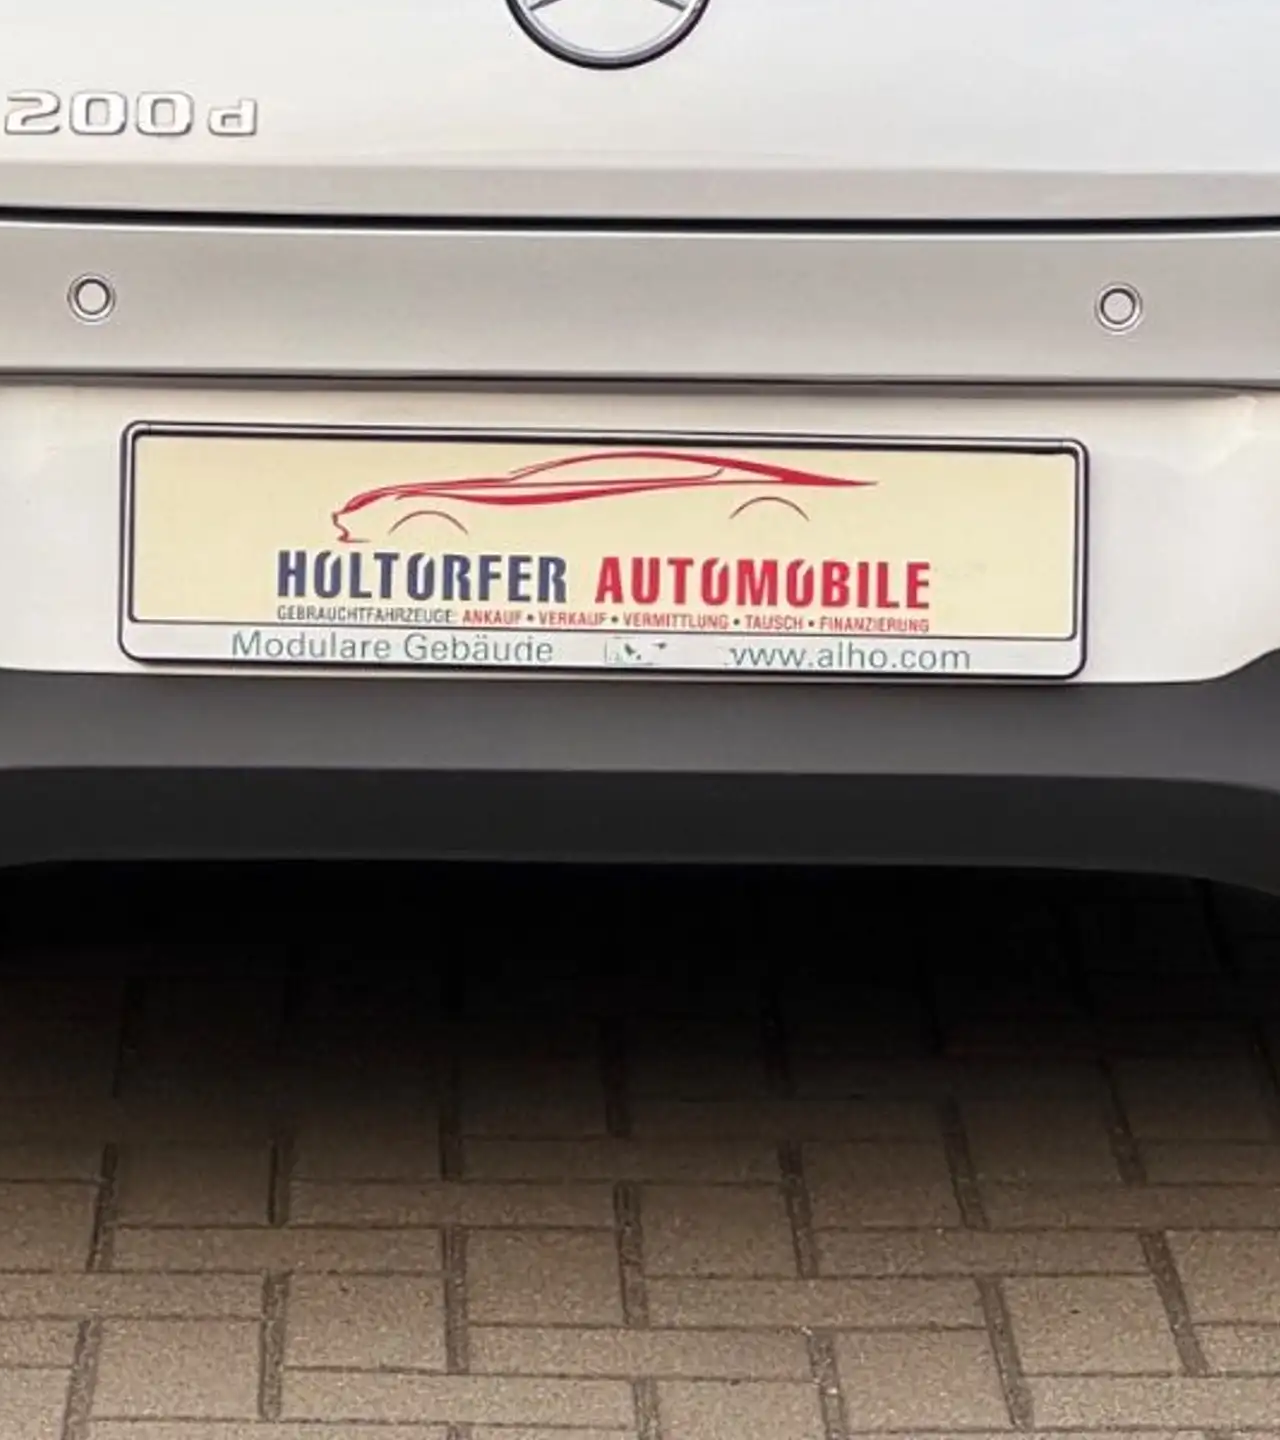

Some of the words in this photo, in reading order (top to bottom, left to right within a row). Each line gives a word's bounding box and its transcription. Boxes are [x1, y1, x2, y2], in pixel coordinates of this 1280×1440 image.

[277, 549, 568, 604] HOLTORFER
[594, 556, 931, 611] AUTOMOBILE
[462, 608, 522, 627] ANKAUF
[538, 610, 609, 628] VERKAUF
[622, 613, 729, 631] VERMITTLUNG
[744, 615, 804, 632] TAUSCH
[819, 617, 930, 634] FINANZIERUNG
[231, 630, 392, 661] Modulare
[403, 632, 554, 663] Gebäude
